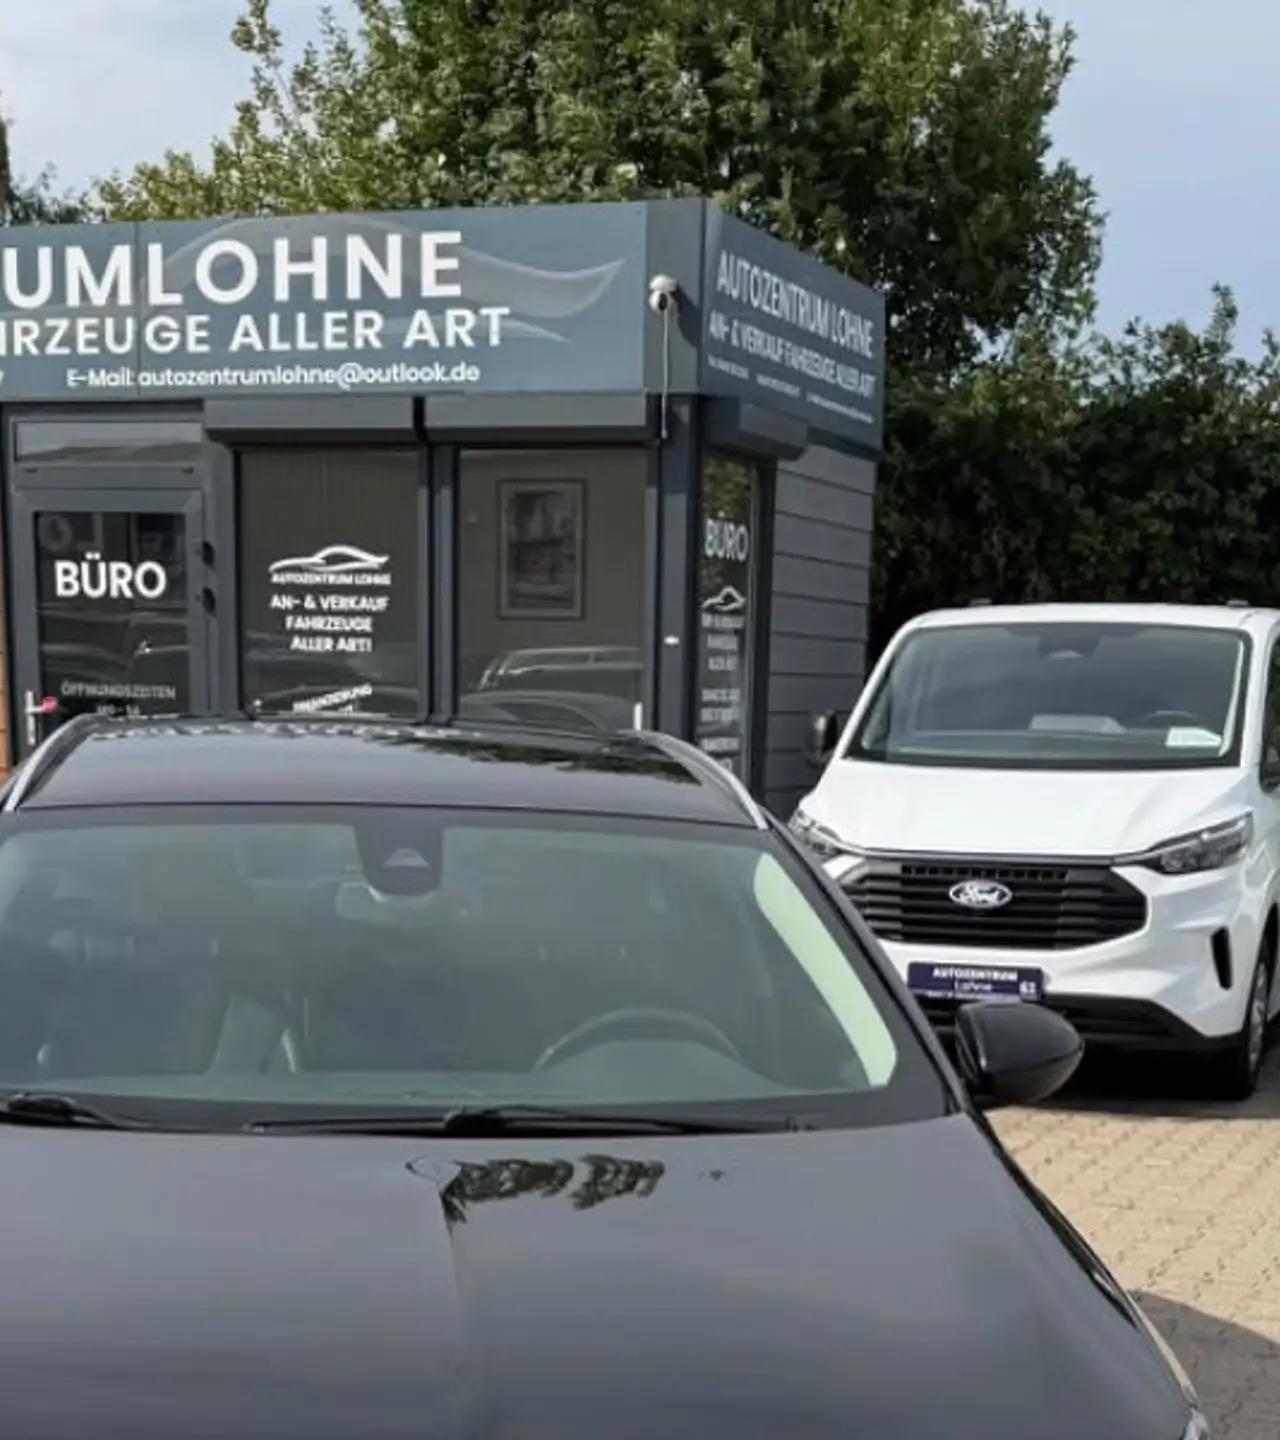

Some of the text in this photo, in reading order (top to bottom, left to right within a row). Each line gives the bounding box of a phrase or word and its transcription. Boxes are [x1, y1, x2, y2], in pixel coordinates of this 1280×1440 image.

[229, 309, 383, 352] ALLER
[403, 306, 511, 348] ART
[137, 361, 481, 391] autozentrumlohne@outlook.de
[705, 510, 748, 562] BÜRO
[55, 551, 166, 599] BÜRO
[933, 967, 1018, 981] AUTOZENTRUM
